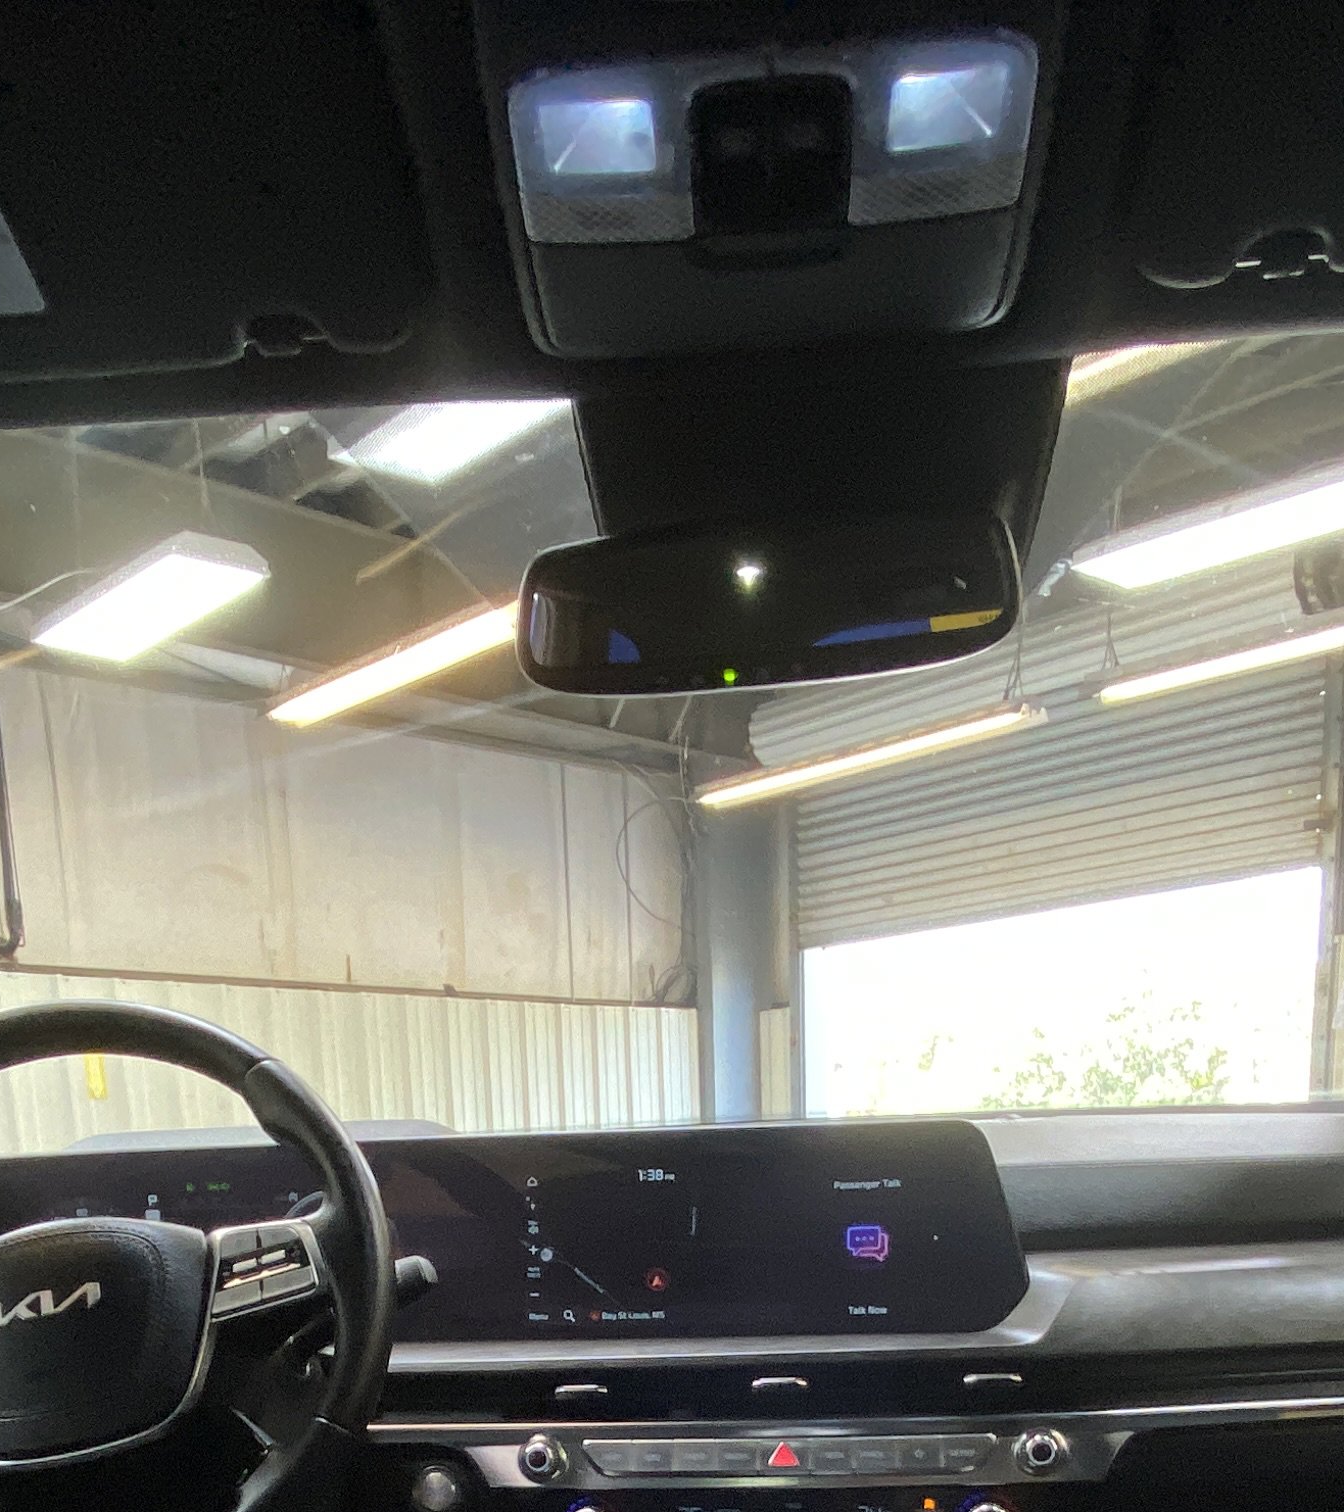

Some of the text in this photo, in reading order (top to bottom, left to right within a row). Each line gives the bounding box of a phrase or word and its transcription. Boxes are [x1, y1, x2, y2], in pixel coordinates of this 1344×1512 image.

[638, 1168, 664, 1182] 1:38
[882, 1178, 902, 1188] Talk
[848, 1306, 866, 1315] Talk
